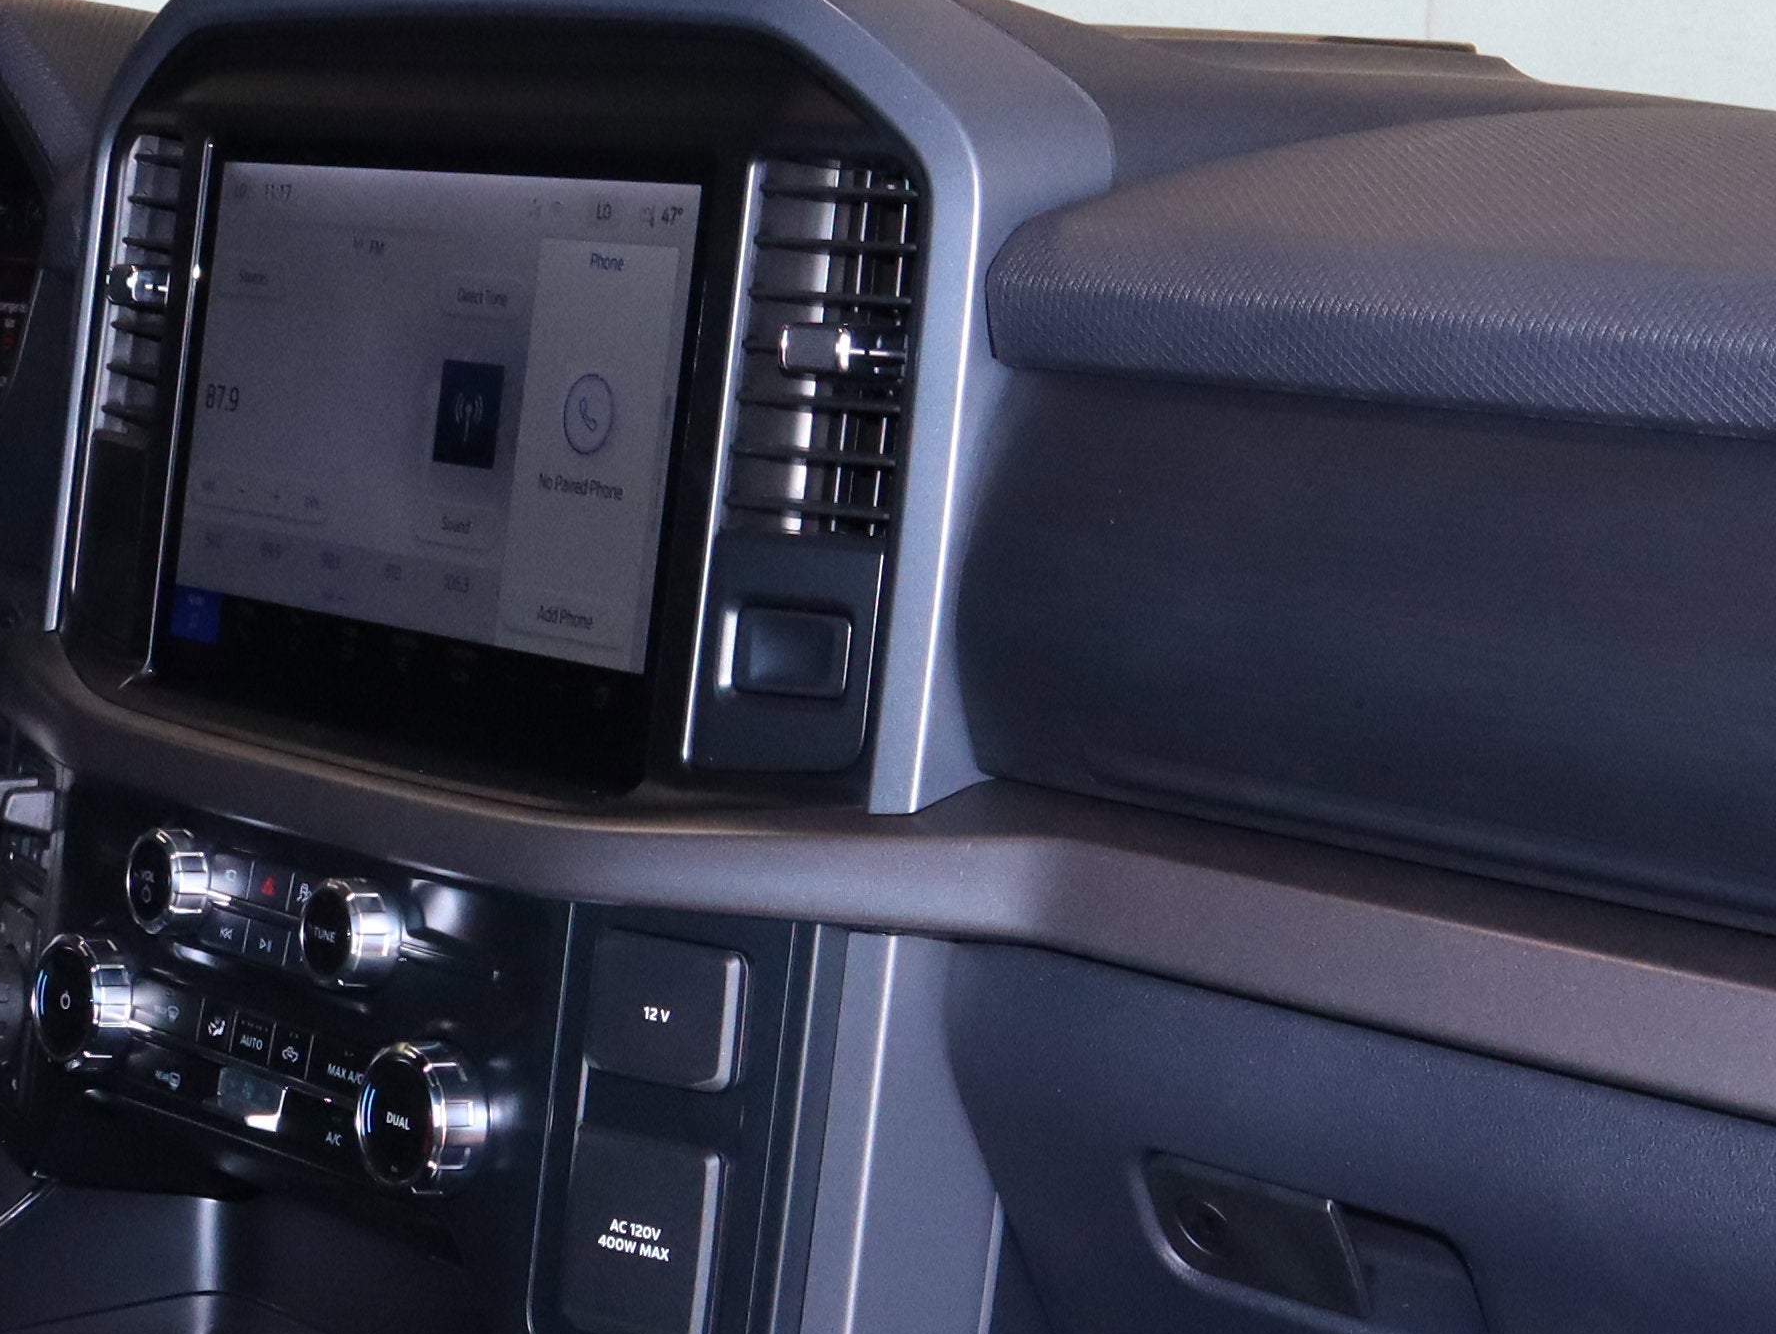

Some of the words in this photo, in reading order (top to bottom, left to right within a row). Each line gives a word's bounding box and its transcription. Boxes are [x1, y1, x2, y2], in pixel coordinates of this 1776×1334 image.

[590, 252, 625, 272] Phone
[205, 383, 240, 412] 87.9
[538, 472, 554, 491] No
[554, 475, 588, 496] Paired
[588, 479, 624, 501] Phone
[536, 605, 558, 625] Add
[559, 608, 594, 631] Phone
[313, 926, 337, 944] TUNE
[643, 1005, 659, 1022] 12
[660, 1008, 671, 1023] V
[239, 1033, 264, 1052] AUTO
[327, 1063, 347, 1081] MAX
[385, 1111, 411, 1131] DUAL
[325, 1131, 342, 1147] A/C
[609, 1218, 628, 1234] AC
[629, 1222, 662, 1242] 120V
[597, 1233, 637, 1255] 400W
[639, 1242, 670, 1262] MAX
